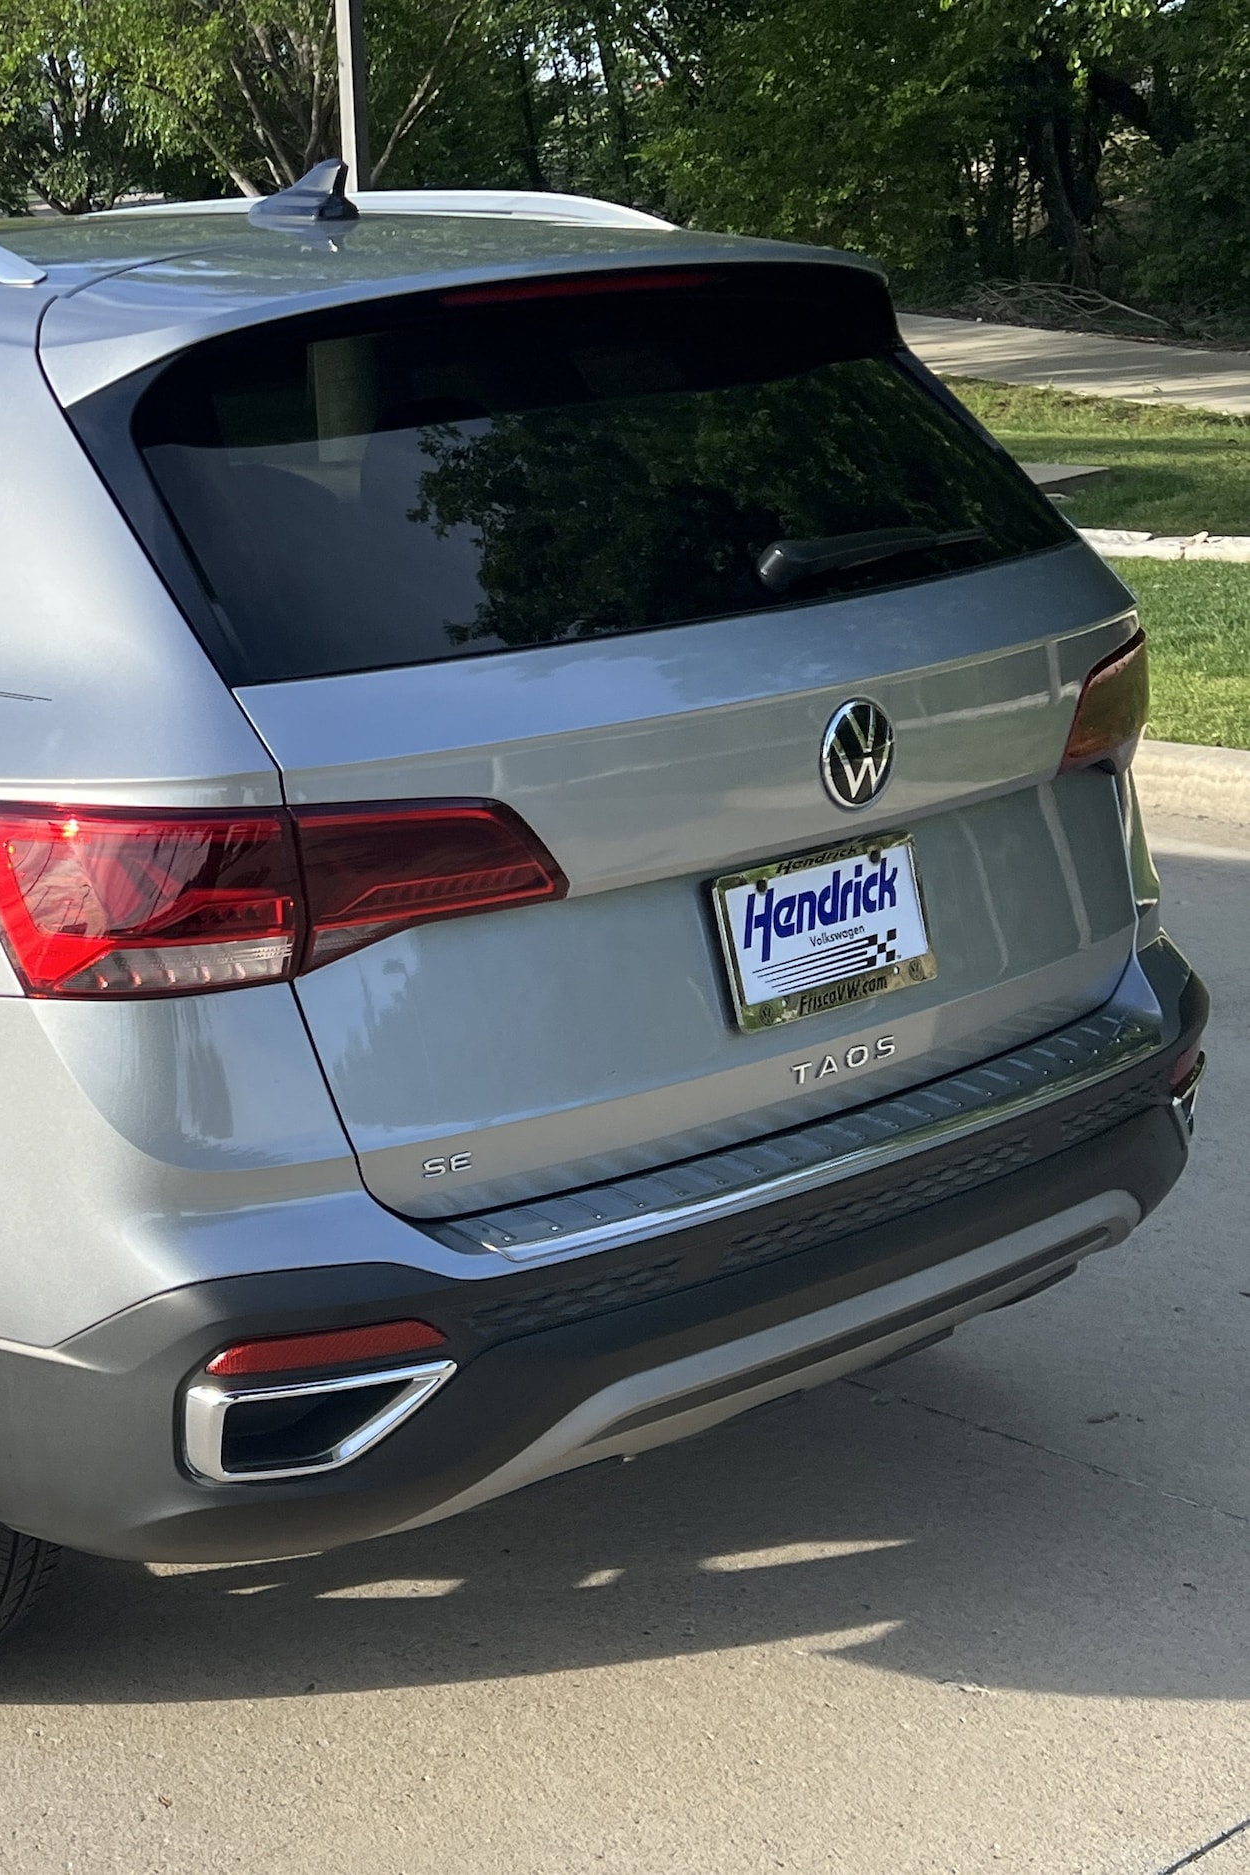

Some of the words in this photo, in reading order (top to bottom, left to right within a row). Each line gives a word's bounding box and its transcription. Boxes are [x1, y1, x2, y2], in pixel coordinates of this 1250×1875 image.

[776, 845, 860, 874] Hendrick
[743, 857, 899, 962] Hendrick
[809, 924, 865, 947] Volkswagen
[798, 976, 888, 1016] FriscoVW.com
[792, 1034, 897, 1085] TAOS
[422, 1150, 474, 1180] SE
